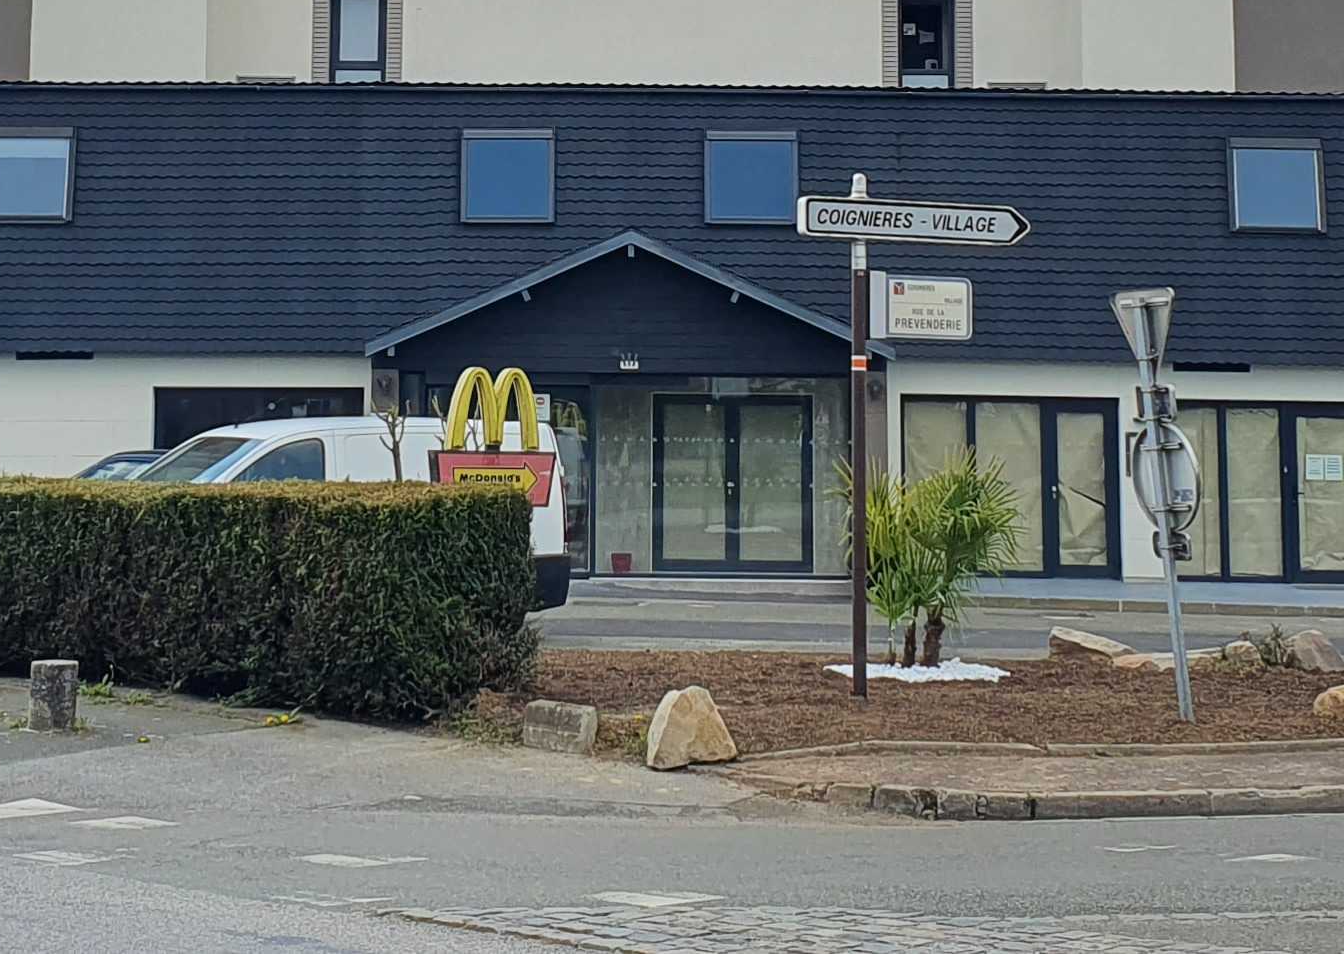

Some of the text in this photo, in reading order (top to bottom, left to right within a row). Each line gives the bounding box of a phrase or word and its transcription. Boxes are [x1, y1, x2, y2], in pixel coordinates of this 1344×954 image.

[816, 208, 914, 229] COIGNIERES
[931, 213, 998, 233] VILLAGE
[912, 308, 924, 316] RUE
[926, 308, 935, 316] DE
[894, 317, 962, 331] PREVENDERIE
[459, 473, 521, 483] McDonald's
